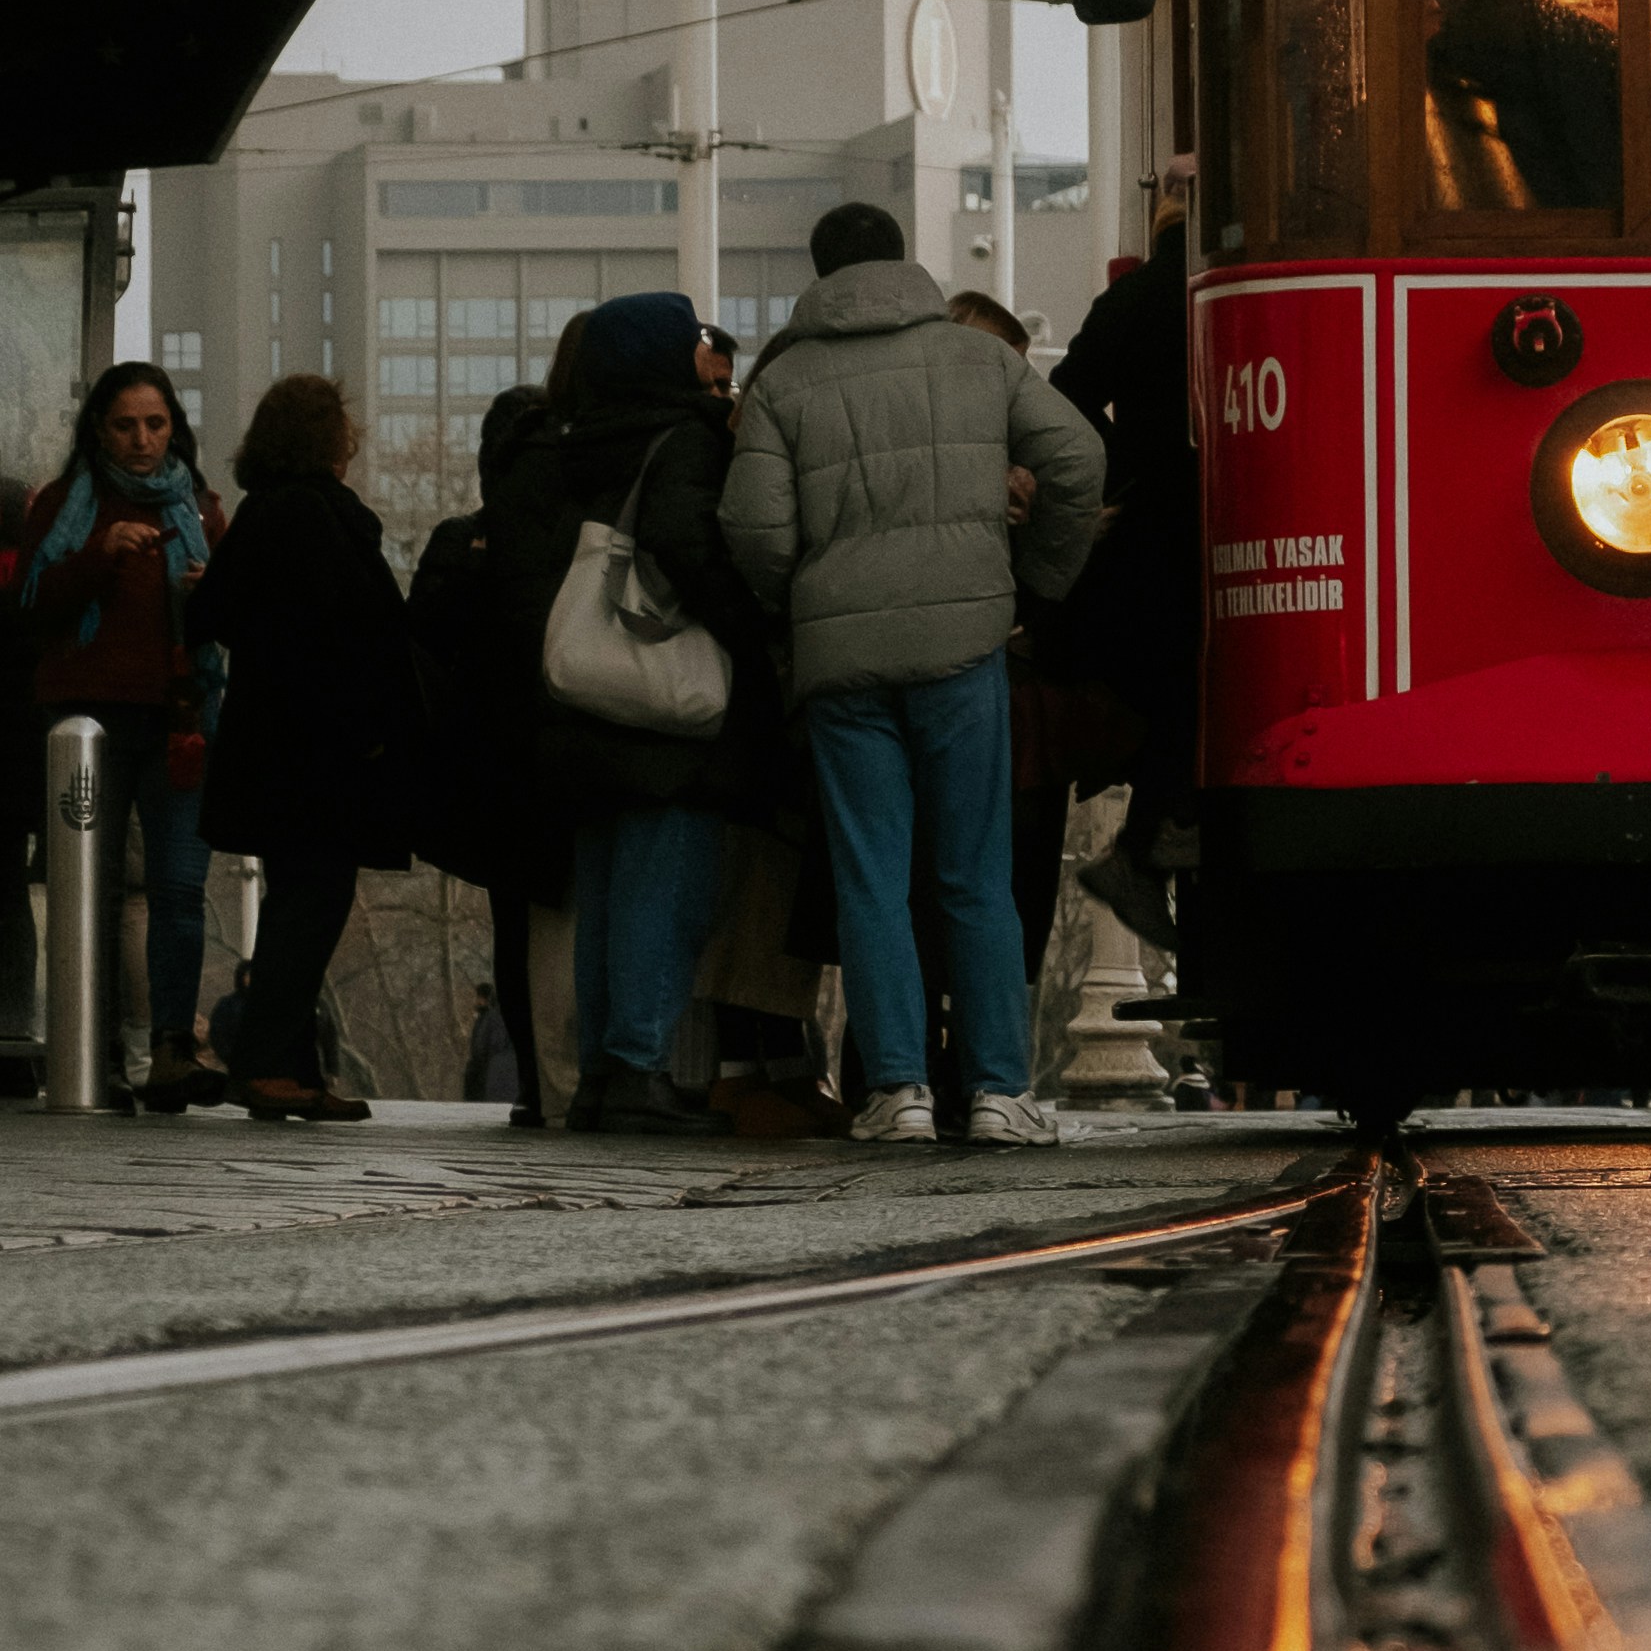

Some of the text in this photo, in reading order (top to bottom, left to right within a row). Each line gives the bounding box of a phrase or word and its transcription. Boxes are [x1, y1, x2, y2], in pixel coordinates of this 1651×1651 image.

[1224, 356, 1286, 434] 410
[1273, 534, 1345, 568] YASAK
[1226, 574, 1343, 618] TEHLİKELİDİR
